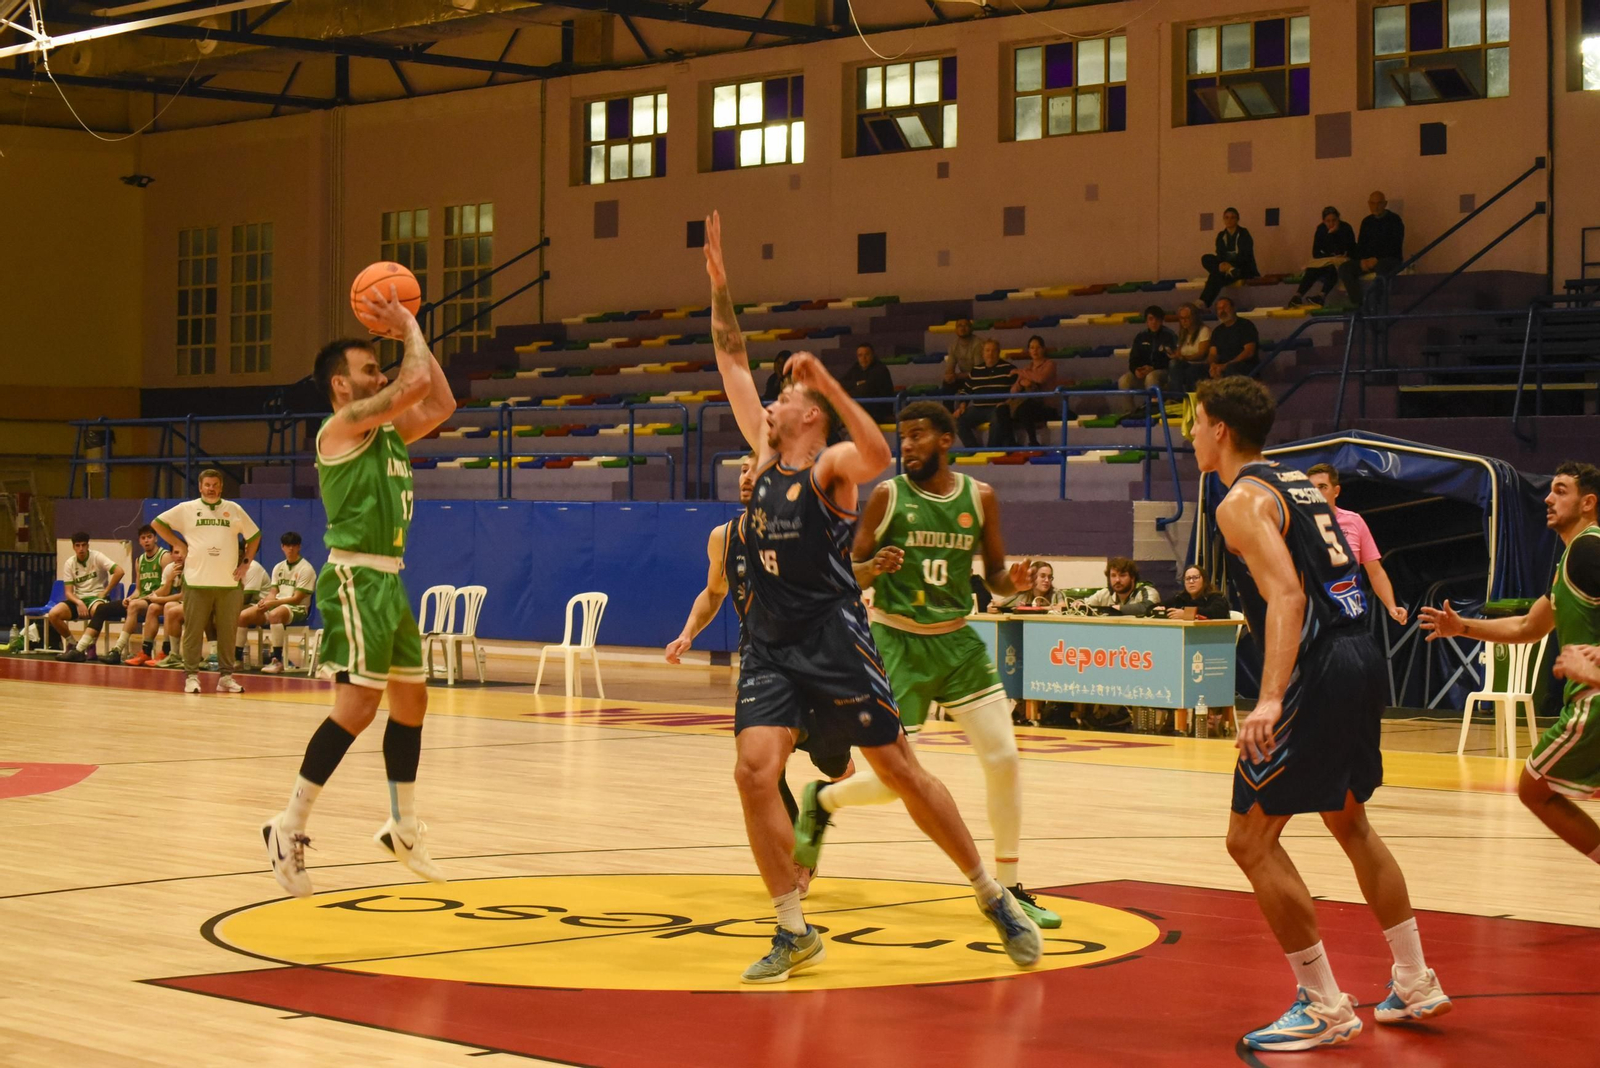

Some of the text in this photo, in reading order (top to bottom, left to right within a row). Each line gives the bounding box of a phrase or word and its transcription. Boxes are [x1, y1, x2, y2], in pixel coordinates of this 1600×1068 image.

[401, 490, 413, 521] 17
[196, 518, 231, 528] ANDUJAR
[904, 530, 974, 551] ANDUJAR
[1314, 514, 1349, 567] 5
[922, 558, 948, 587] 10
[1050, 639, 1153, 673] deportes
[317, 894, 1108, 957] endesa
